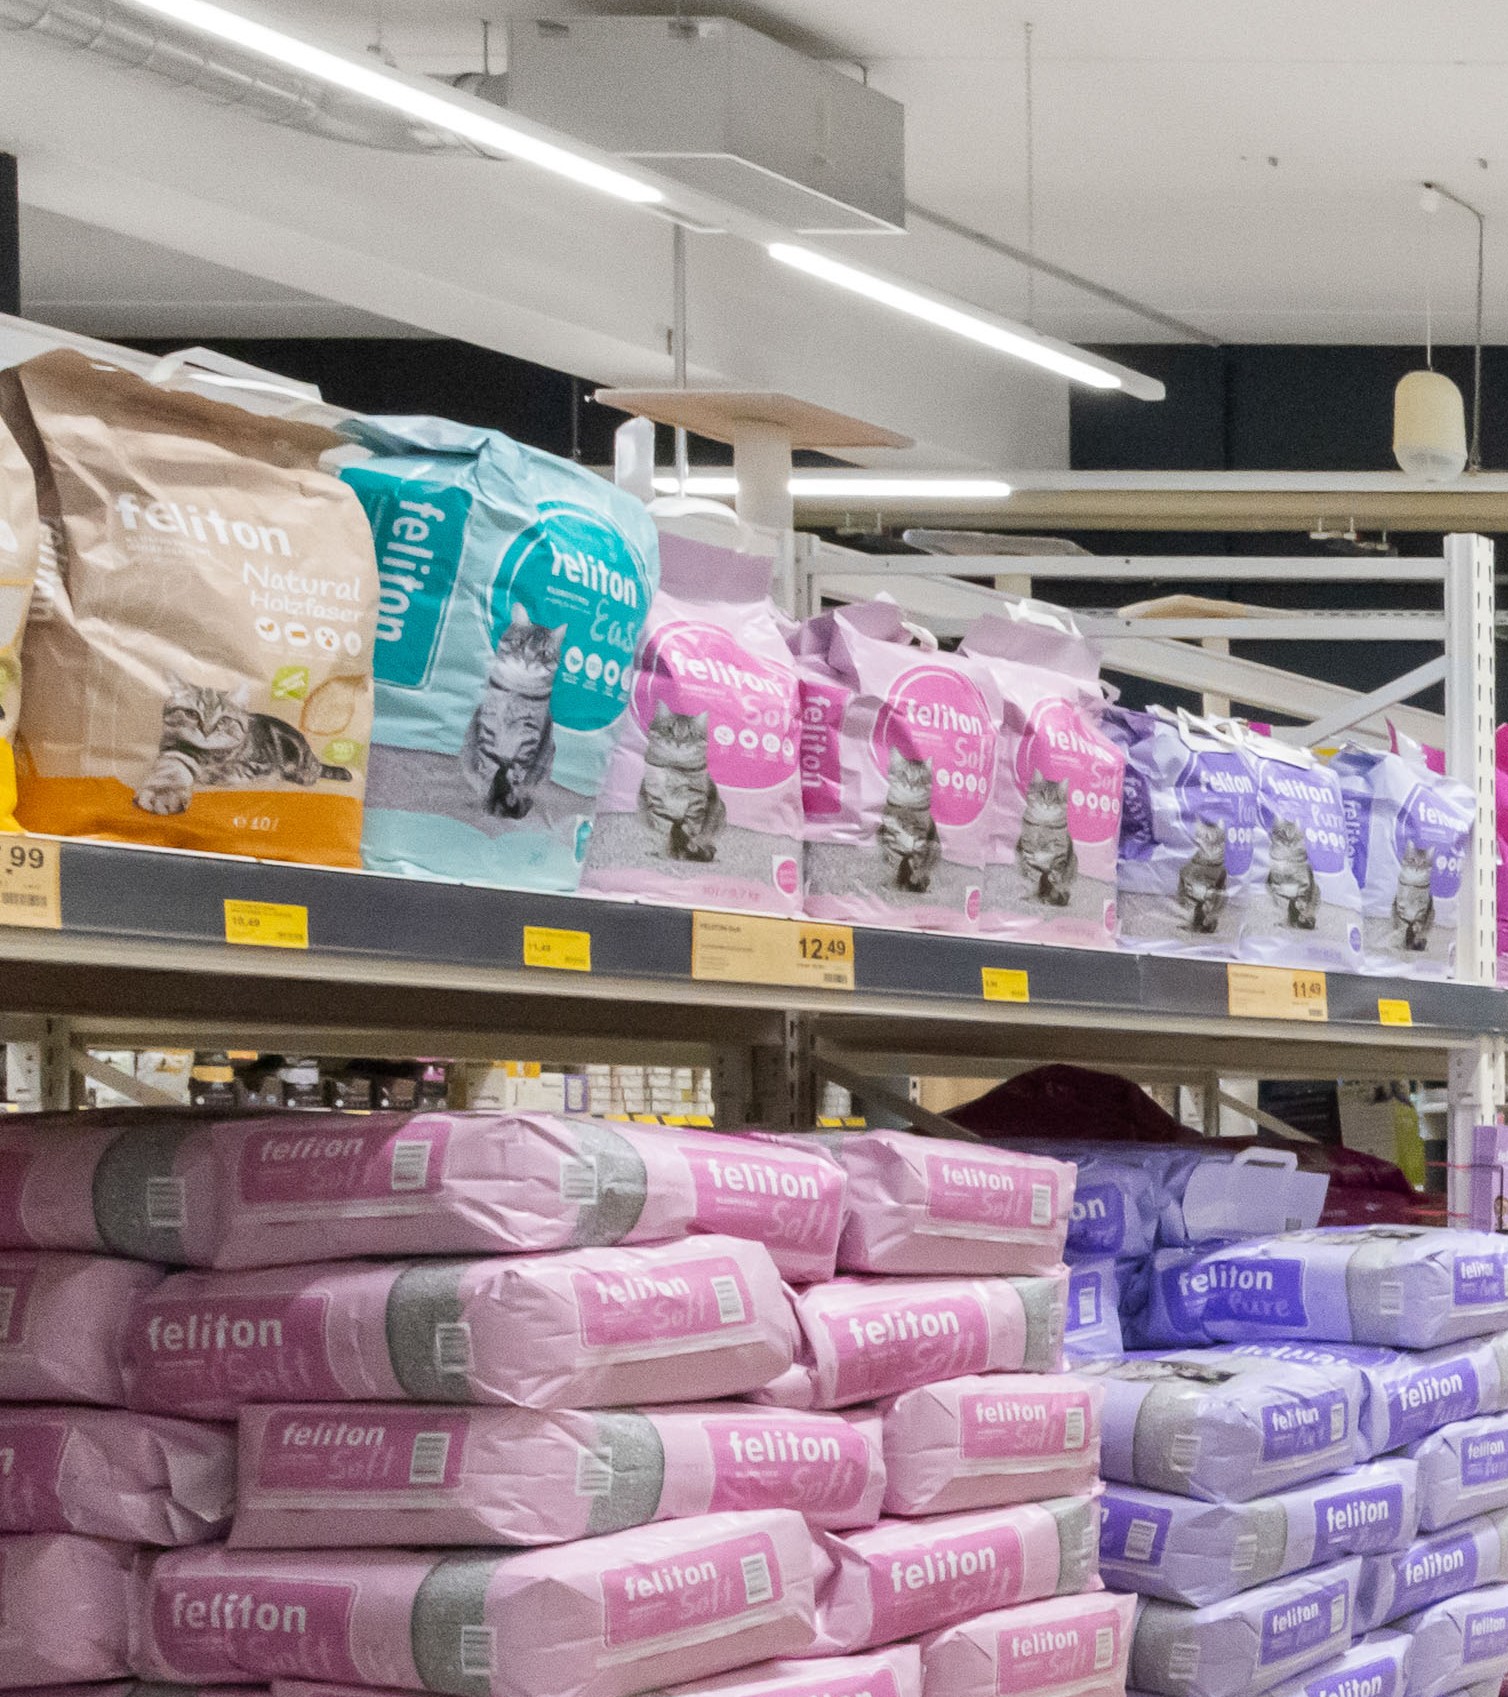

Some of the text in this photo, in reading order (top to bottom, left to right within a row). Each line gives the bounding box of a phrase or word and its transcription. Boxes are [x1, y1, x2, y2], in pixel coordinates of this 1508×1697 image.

[116, 493, 292, 557] feliton
[241, 560, 361, 601] Natural
[906, 697, 983, 736] feliton
[1268, 774, 1334, 805] feliton
[798, 935, 846, 960] 12.49
[1291, 980, 1321, 999] 11.49
[707, 1158, 820, 1201] feliton
[941, 1166, 1014, 1193] feliton
[146, 1314, 283, 1353] feliton
[848, 1307, 960, 1349] feliton
[729, 1428, 841, 1464] feliton
[1326, 1498, 1389, 1529] feliton
[891, 1544, 996, 1593] feliton
